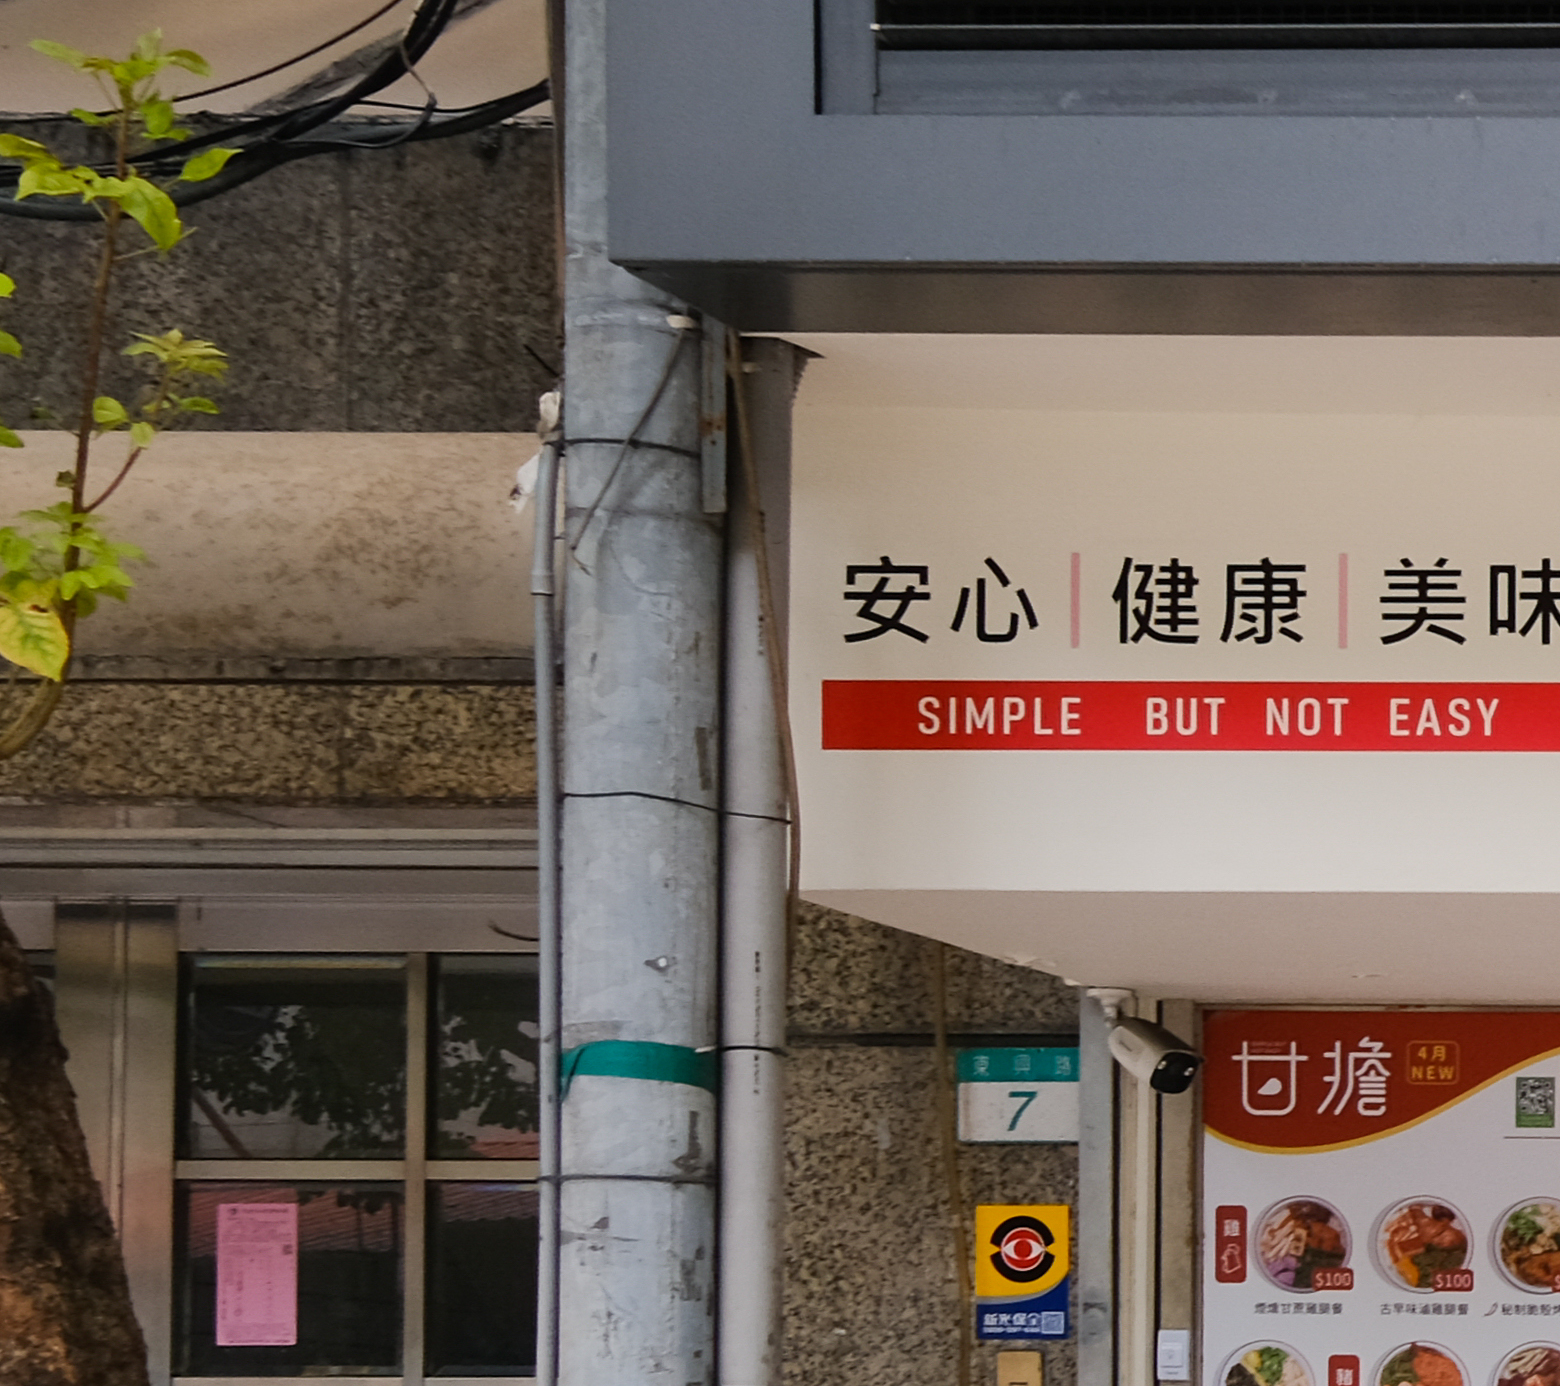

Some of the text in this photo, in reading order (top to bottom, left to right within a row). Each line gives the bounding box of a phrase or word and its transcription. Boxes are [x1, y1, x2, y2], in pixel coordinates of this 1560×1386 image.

[841, 554, 1041, 645] 安心
[1110, 554, 1309, 645] 健康
[916, 694, 1502, 738] SIMPLE BUT NOT EASY
[1416, 1044, 1447, 1061] 4月
[1231, 1035, 1393, 1117] 甘擔
[1411, 1065, 1455, 1081] NEW
[1006, 1090, 1039, 1132] 7
[1314, 1270, 1352, 1288] $100
[1434, 1272, 1472, 1289] $100
